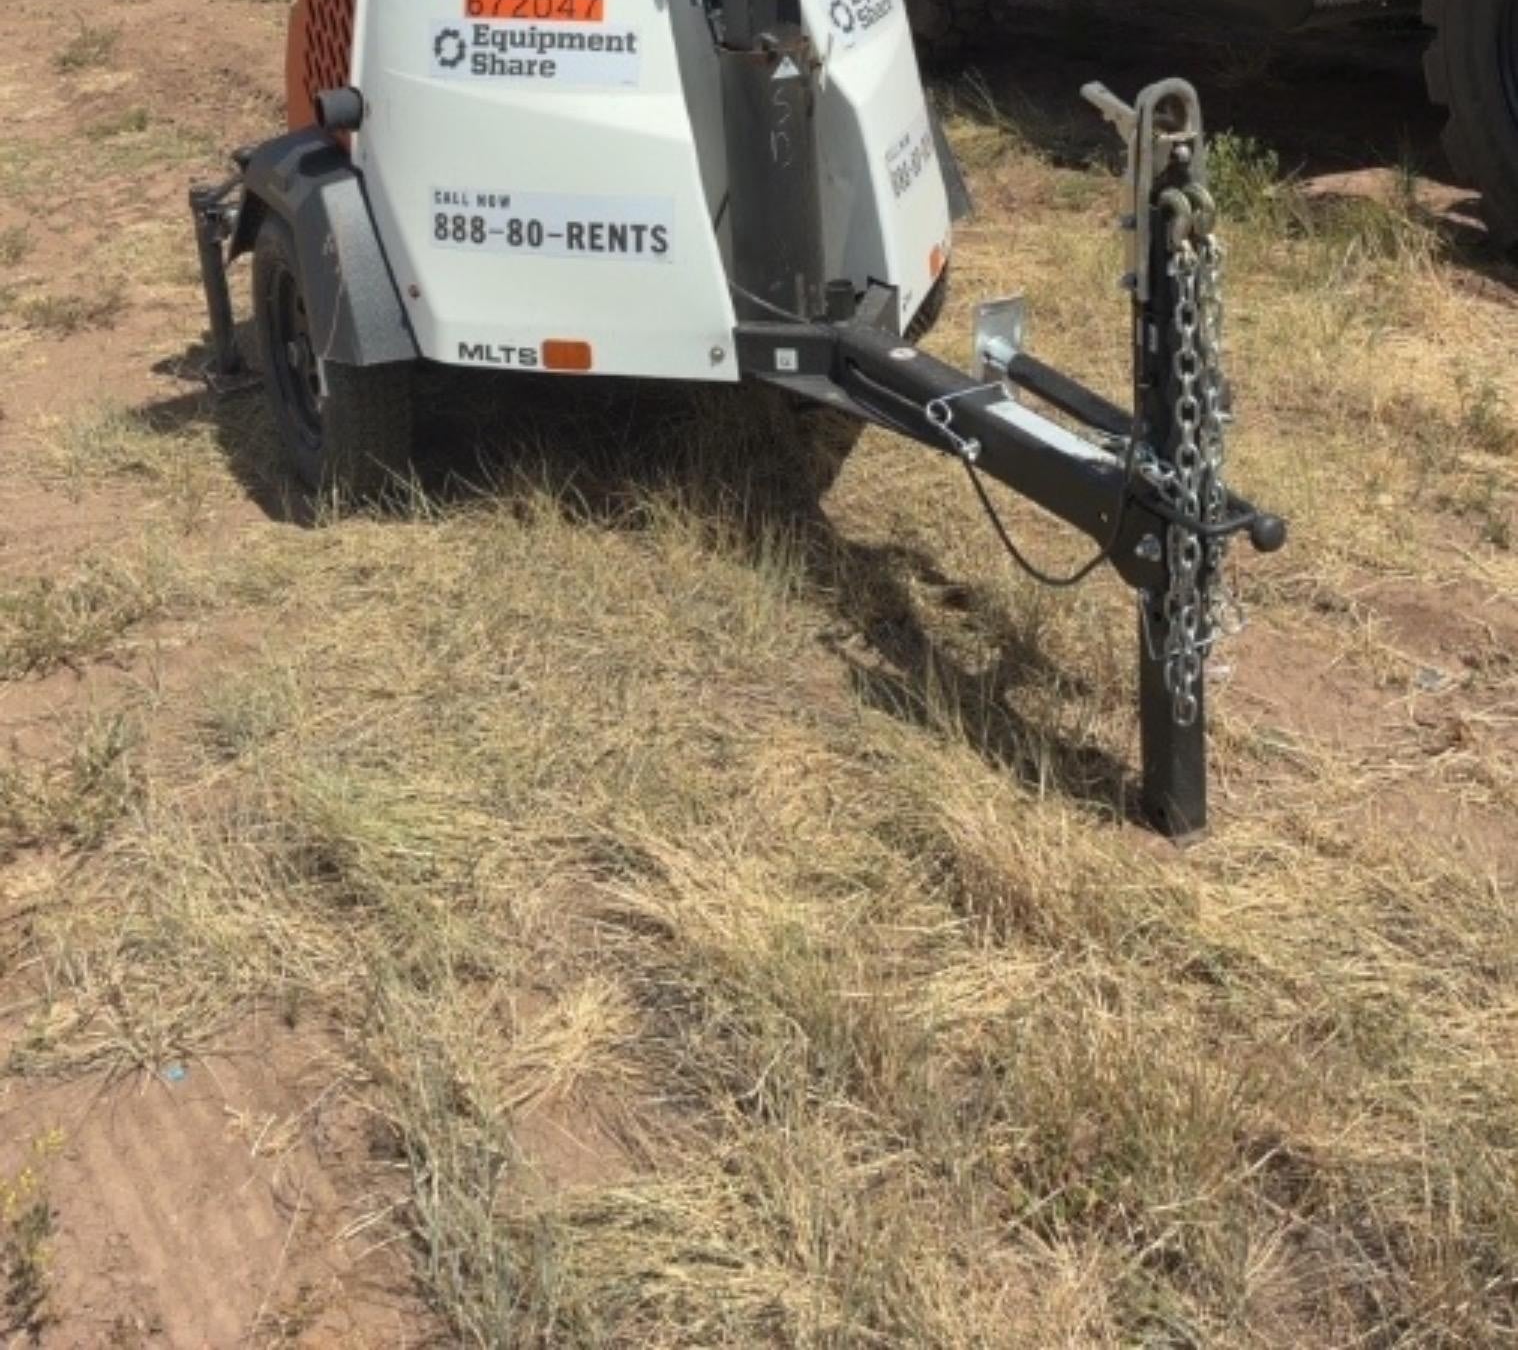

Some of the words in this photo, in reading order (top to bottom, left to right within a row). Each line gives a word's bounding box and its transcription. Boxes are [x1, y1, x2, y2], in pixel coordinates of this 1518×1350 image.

[471, 24, 637, 54] Equipment
[471, 53, 556, 77] Share
[434, 191, 469, 207] CALL
[476, 194, 511, 208] NOW
[434, 213, 668, 254] 888-80-RENTS
[458, 342, 538, 366] MLTS
